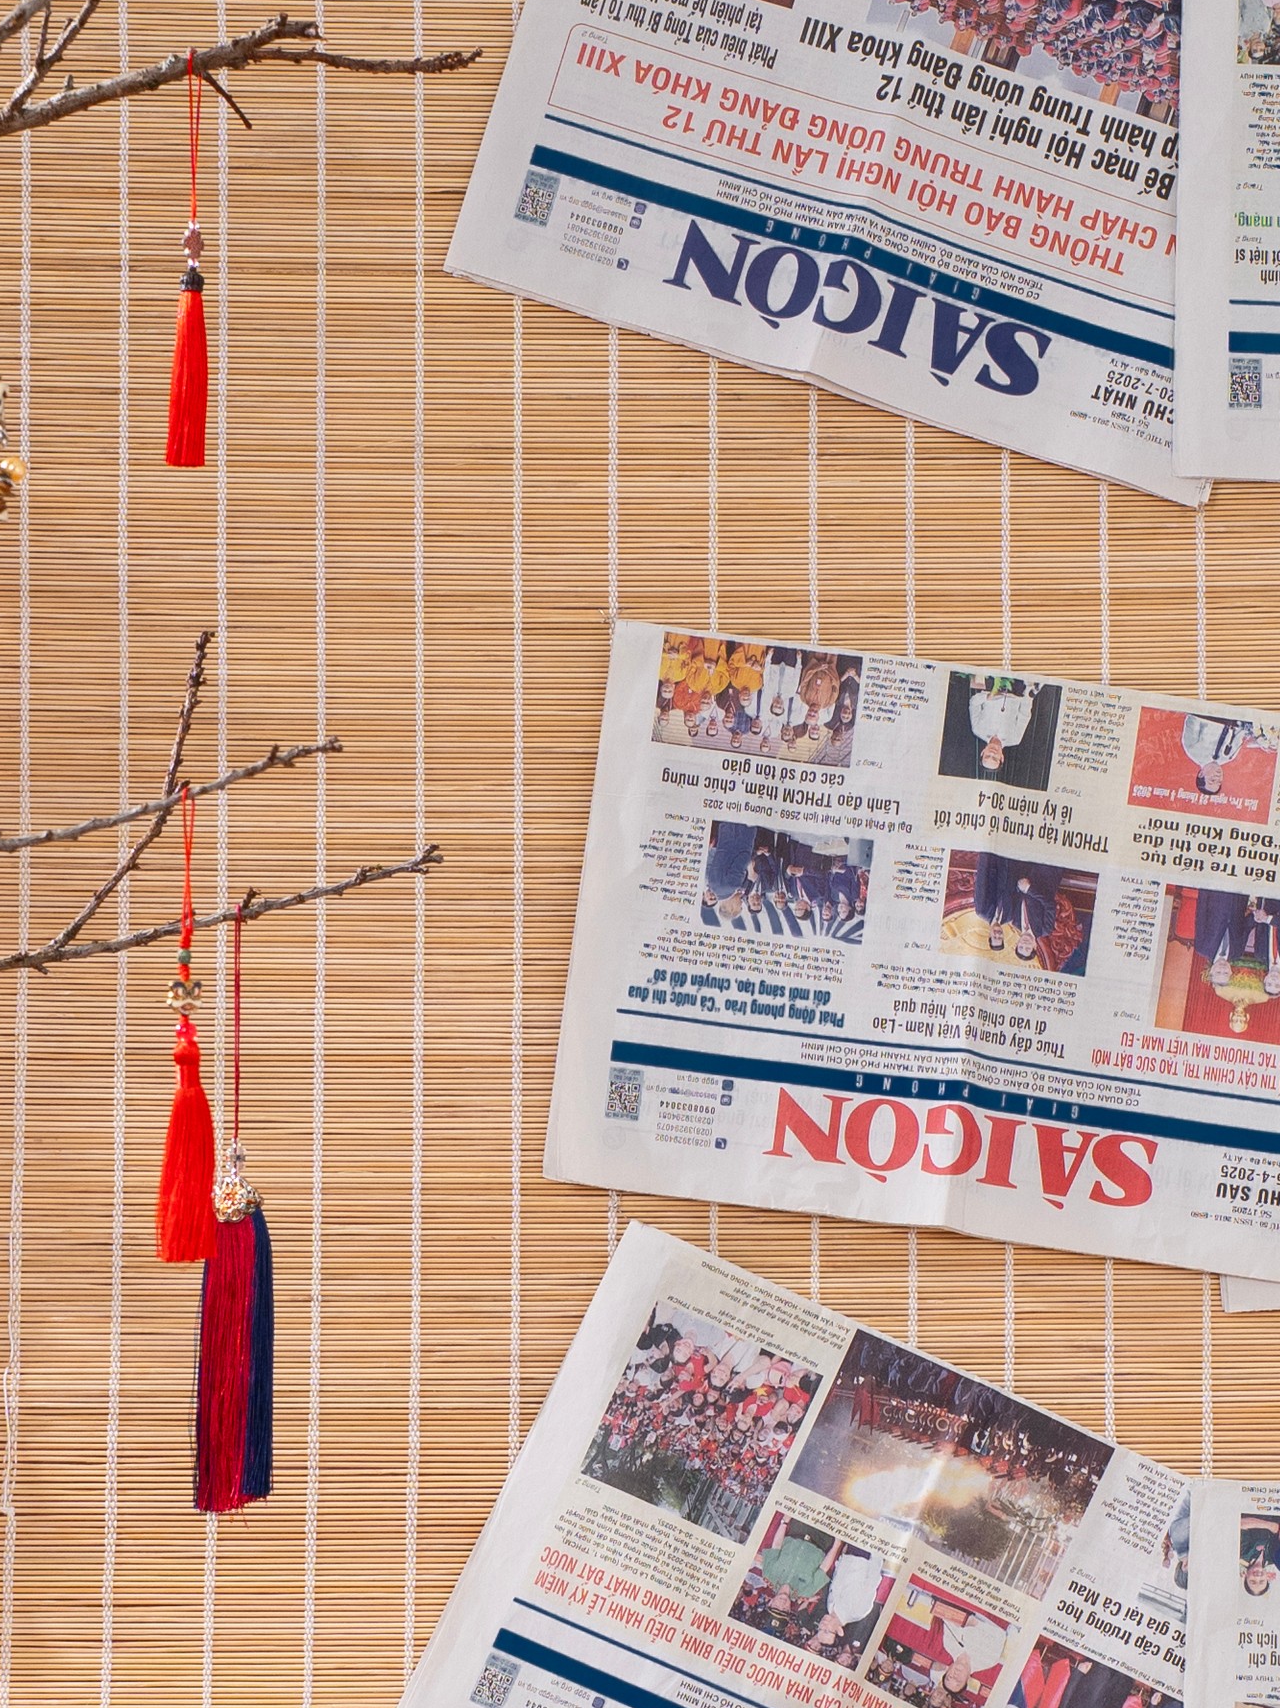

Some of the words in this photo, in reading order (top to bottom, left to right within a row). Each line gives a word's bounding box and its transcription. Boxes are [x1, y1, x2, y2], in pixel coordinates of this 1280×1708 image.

[662, 104, 694, 133] 12
[701, 119, 761, 156] THỨ
[771, 138, 829, 175] LẦN
[835, 156, 901, 194] NGHỊ
[907, 178, 957, 216] HỘI
[964, 201, 1022, 239] BÁO
[1029, 222, 1124, 275] THÔNG
[1215, 1182, 1251, 1203] SÁU
